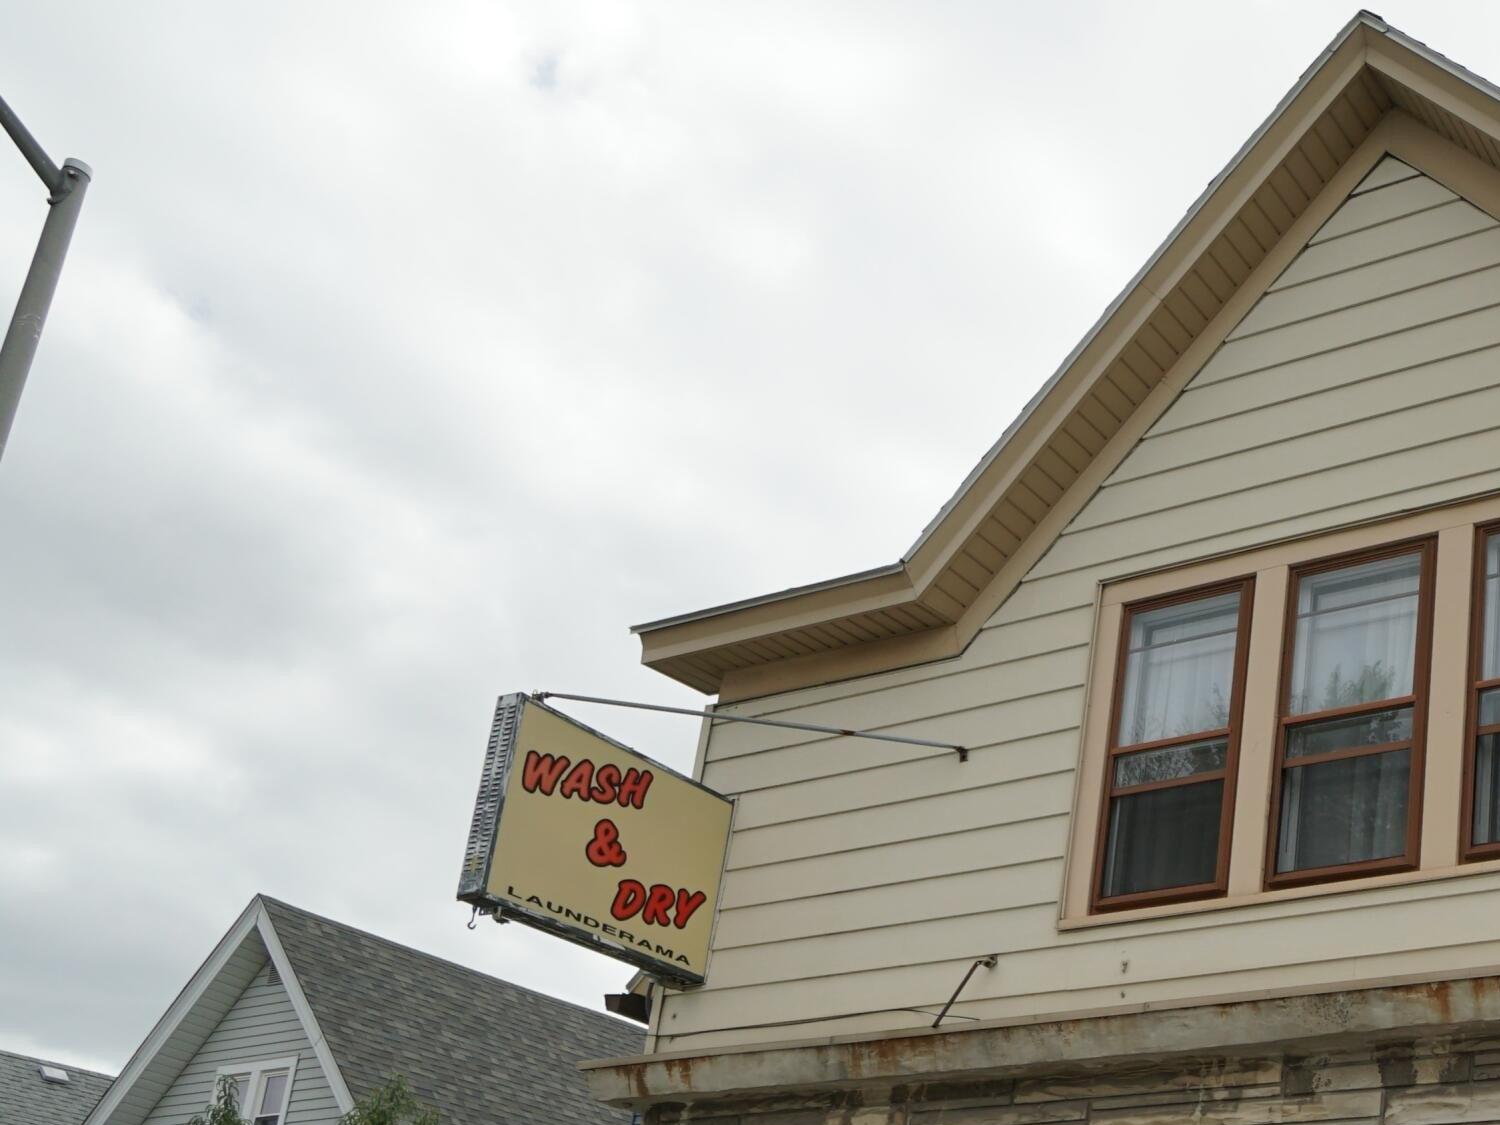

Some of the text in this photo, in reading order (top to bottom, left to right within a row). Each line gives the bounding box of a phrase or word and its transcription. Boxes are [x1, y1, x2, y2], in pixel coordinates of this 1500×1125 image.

[522, 750, 654, 810] WASH
[585, 818, 627, 868] &
[507, 885, 690, 966] LAUNDERAMA
[610, 879, 706, 930] DRY
